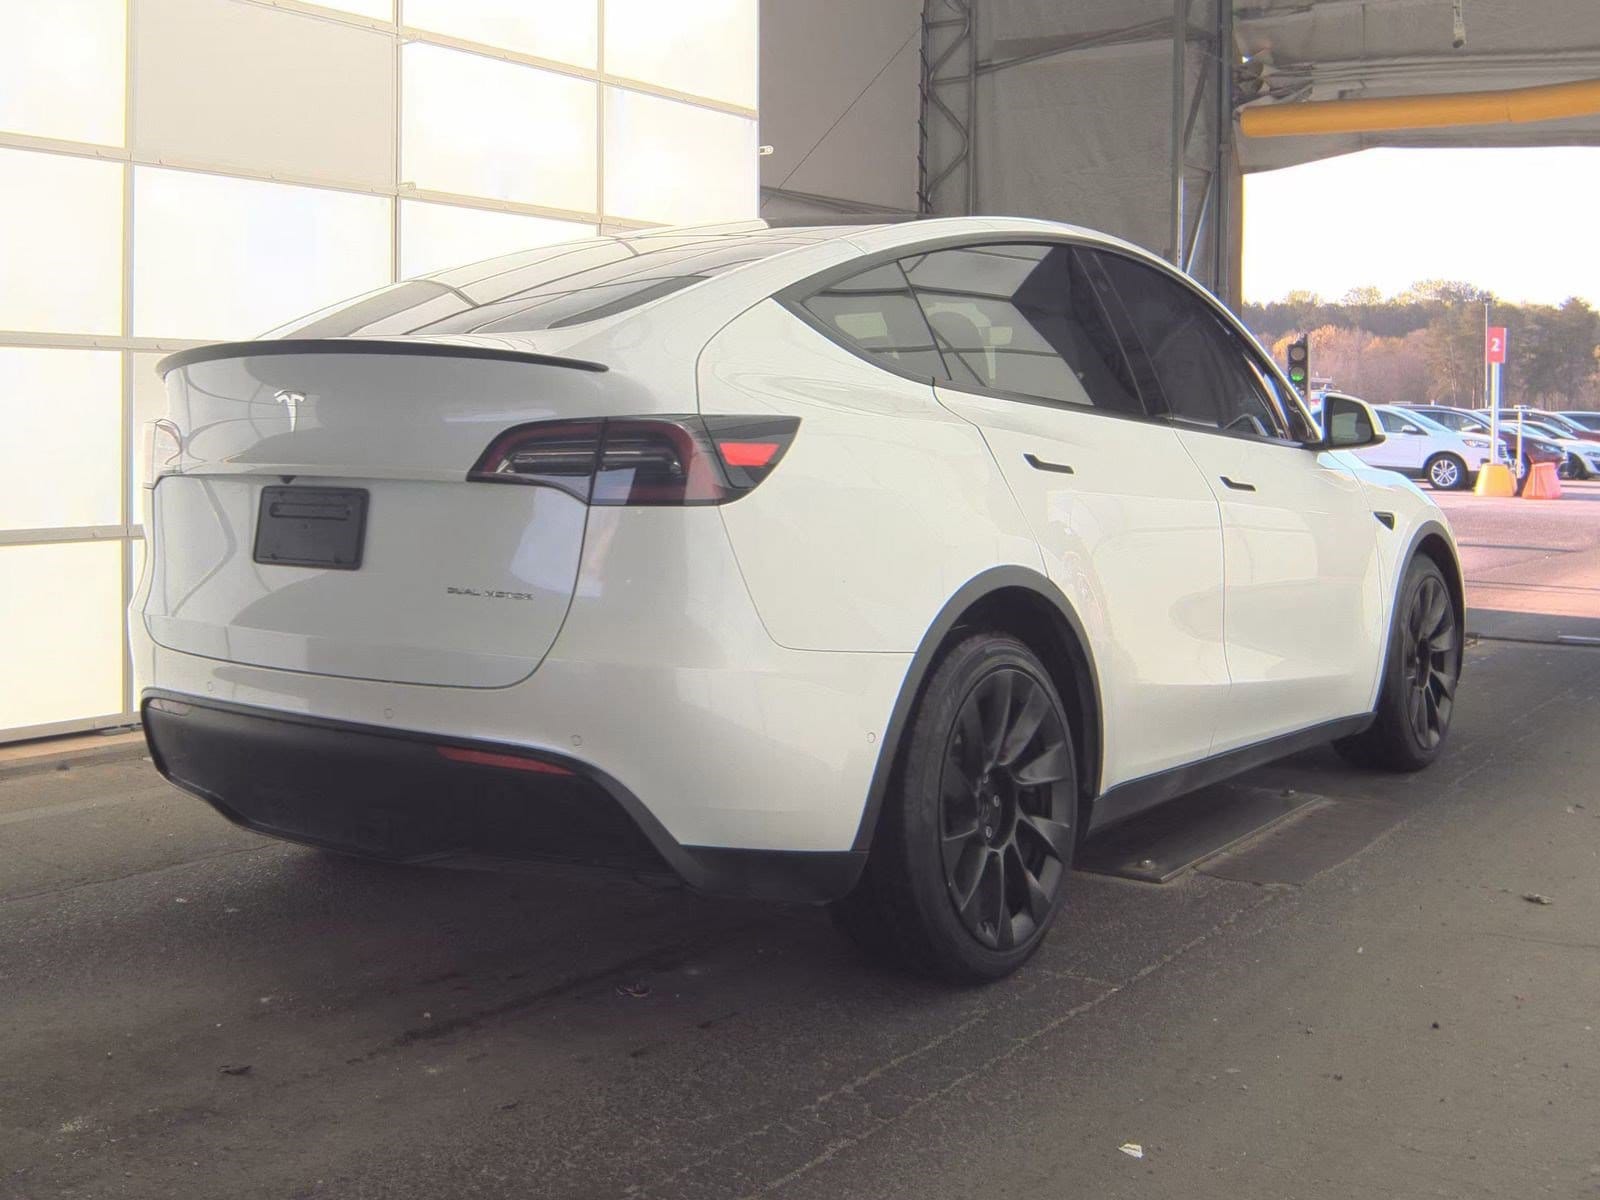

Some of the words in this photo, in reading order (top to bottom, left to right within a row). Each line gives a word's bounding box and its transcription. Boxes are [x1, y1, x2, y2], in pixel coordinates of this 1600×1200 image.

[1491, 337, 1500, 352] 2
[447, 587, 481, 597] DUAL
[484, 590, 534, 601] MOTOR
